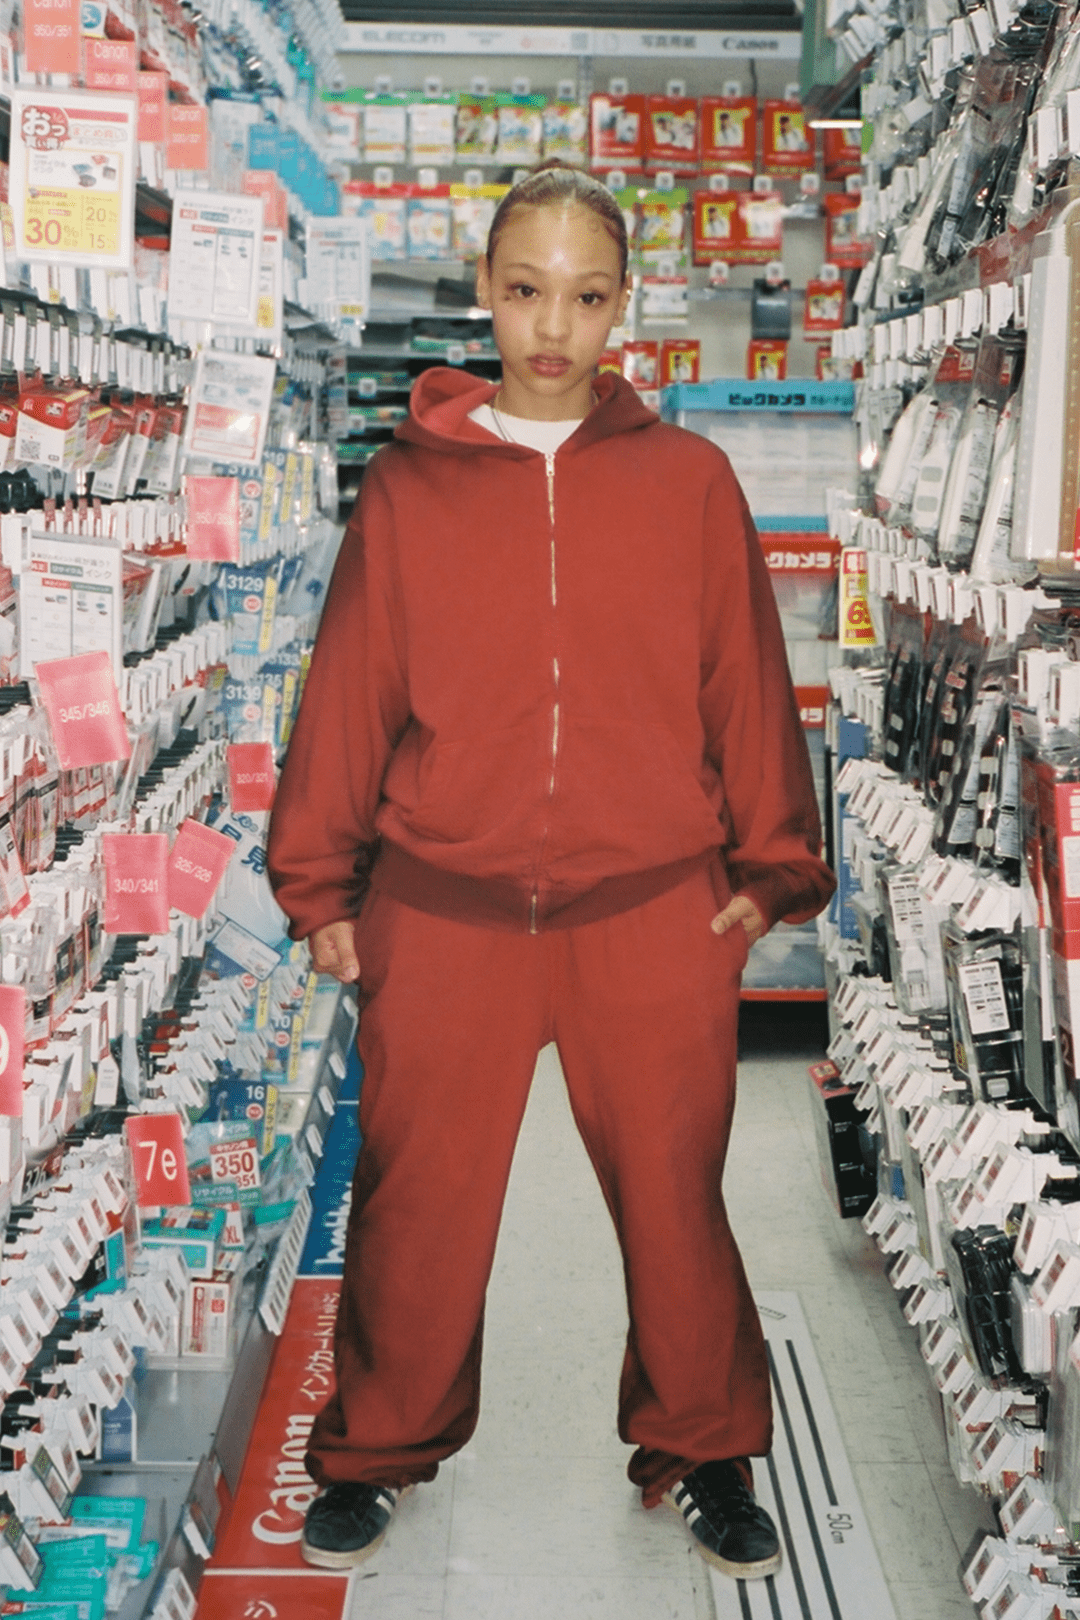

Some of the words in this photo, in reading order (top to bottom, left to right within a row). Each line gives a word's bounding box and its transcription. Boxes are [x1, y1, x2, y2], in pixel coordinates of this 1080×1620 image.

[94, 41, 129, 59] Canon
[722, 37, 779, 50] Canon
[22, 107, 66, 137] おっ
[85, 206, 106, 223] 20
[25, 217, 62, 246] 30
[728, 393, 806, 406] ビックカメラ
[227, 574, 264, 592] 3129
[226, 684, 261, 700] 3139
[60, 701, 110, 723] 345/346
[175, 856, 213, 882] 325/326
[114, 878, 158, 892] 340/341
[246, 1085, 265, 1100] 16
[137, 1139, 178, 1181] 7e
[215, 1151, 254, 1178] 350
[234, 1173, 257, 1188] 351
[224, 1225, 241, 1244] XL
[252, 1414, 319, 1544] Canon
[826, 1513, 853, 1544] 50cm
